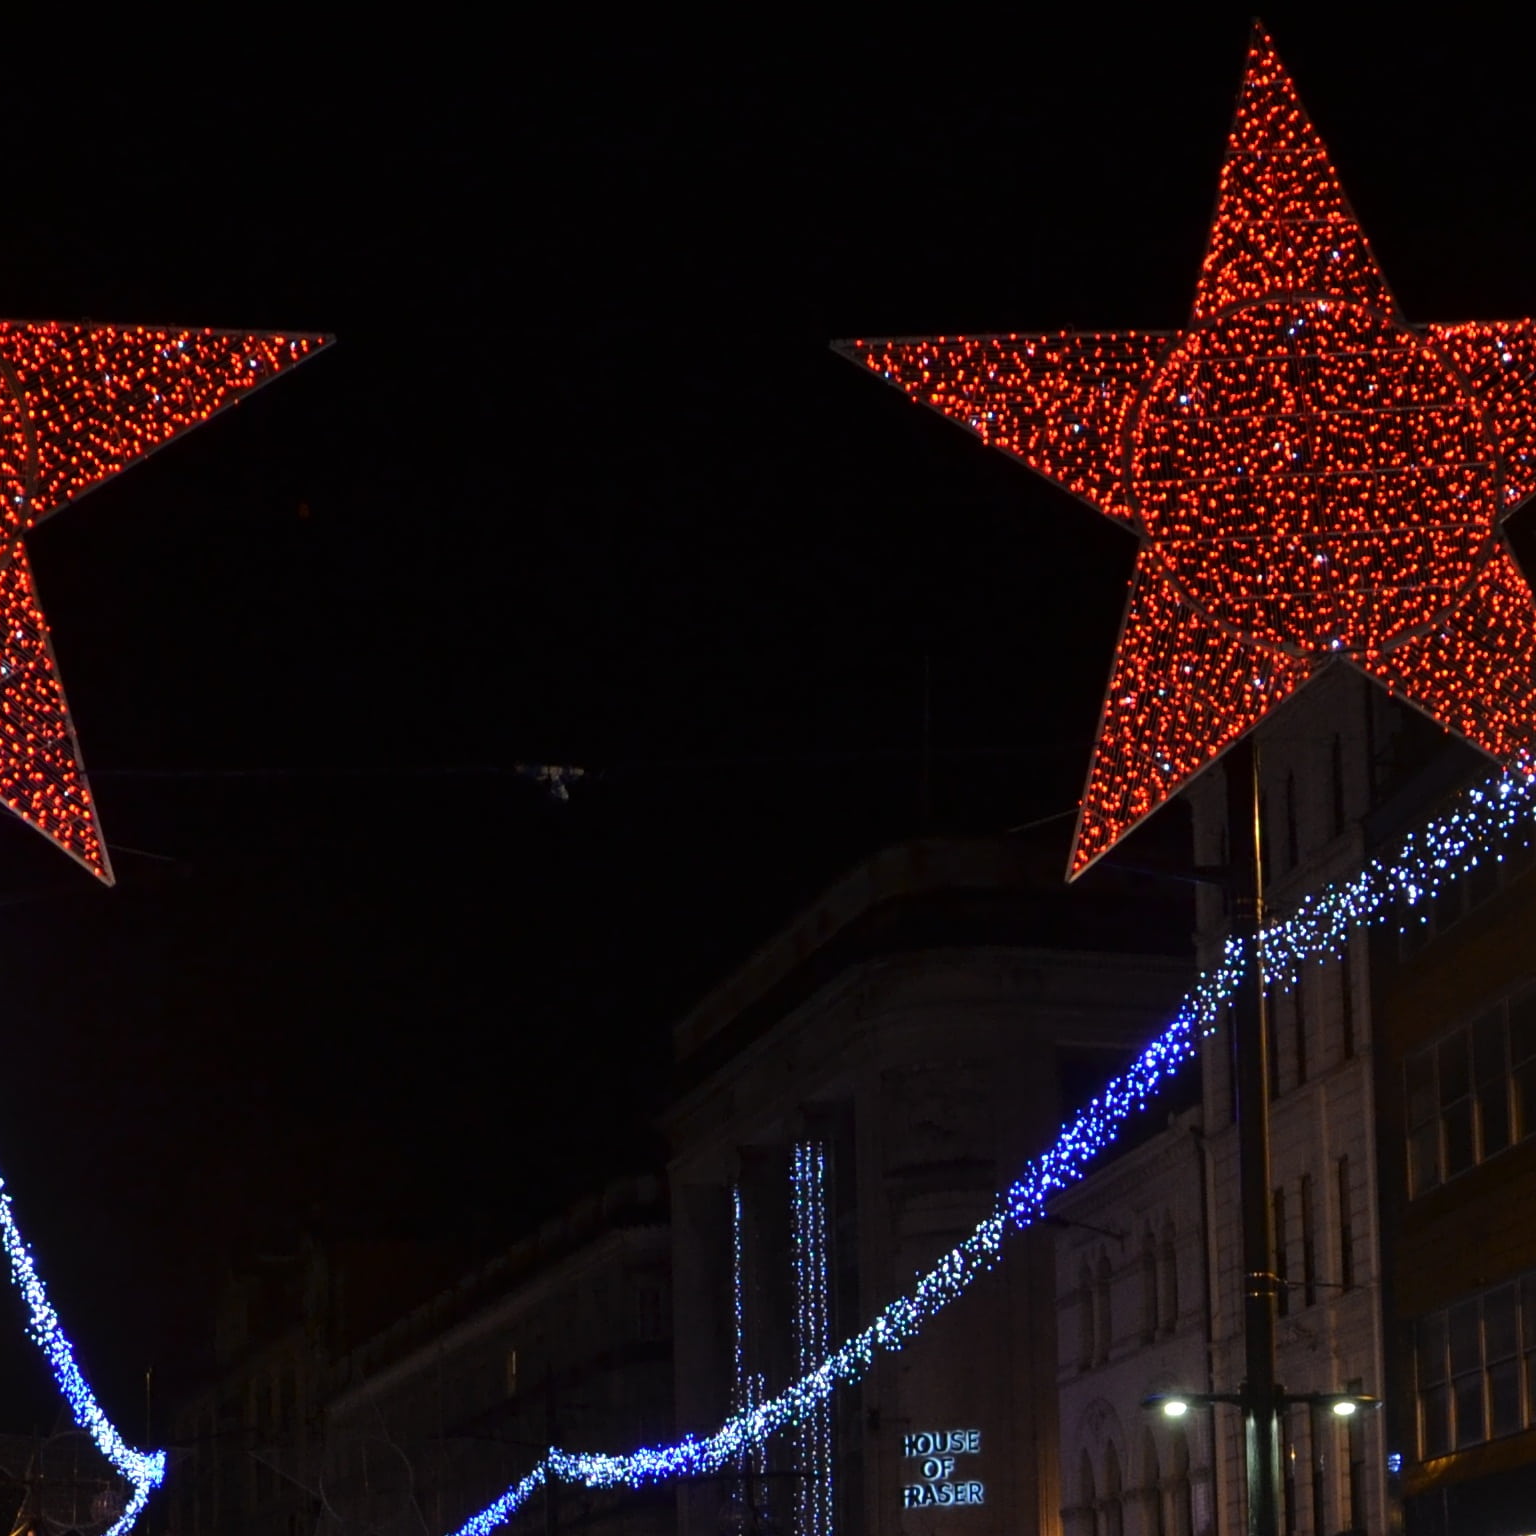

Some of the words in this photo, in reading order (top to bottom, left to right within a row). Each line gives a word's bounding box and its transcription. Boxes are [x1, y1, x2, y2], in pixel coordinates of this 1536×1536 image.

[902, 1429, 981, 1457] HOUSE
[920, 1456, 955, 1481] OF
[901, 1480, 984, 1508] FRASER
